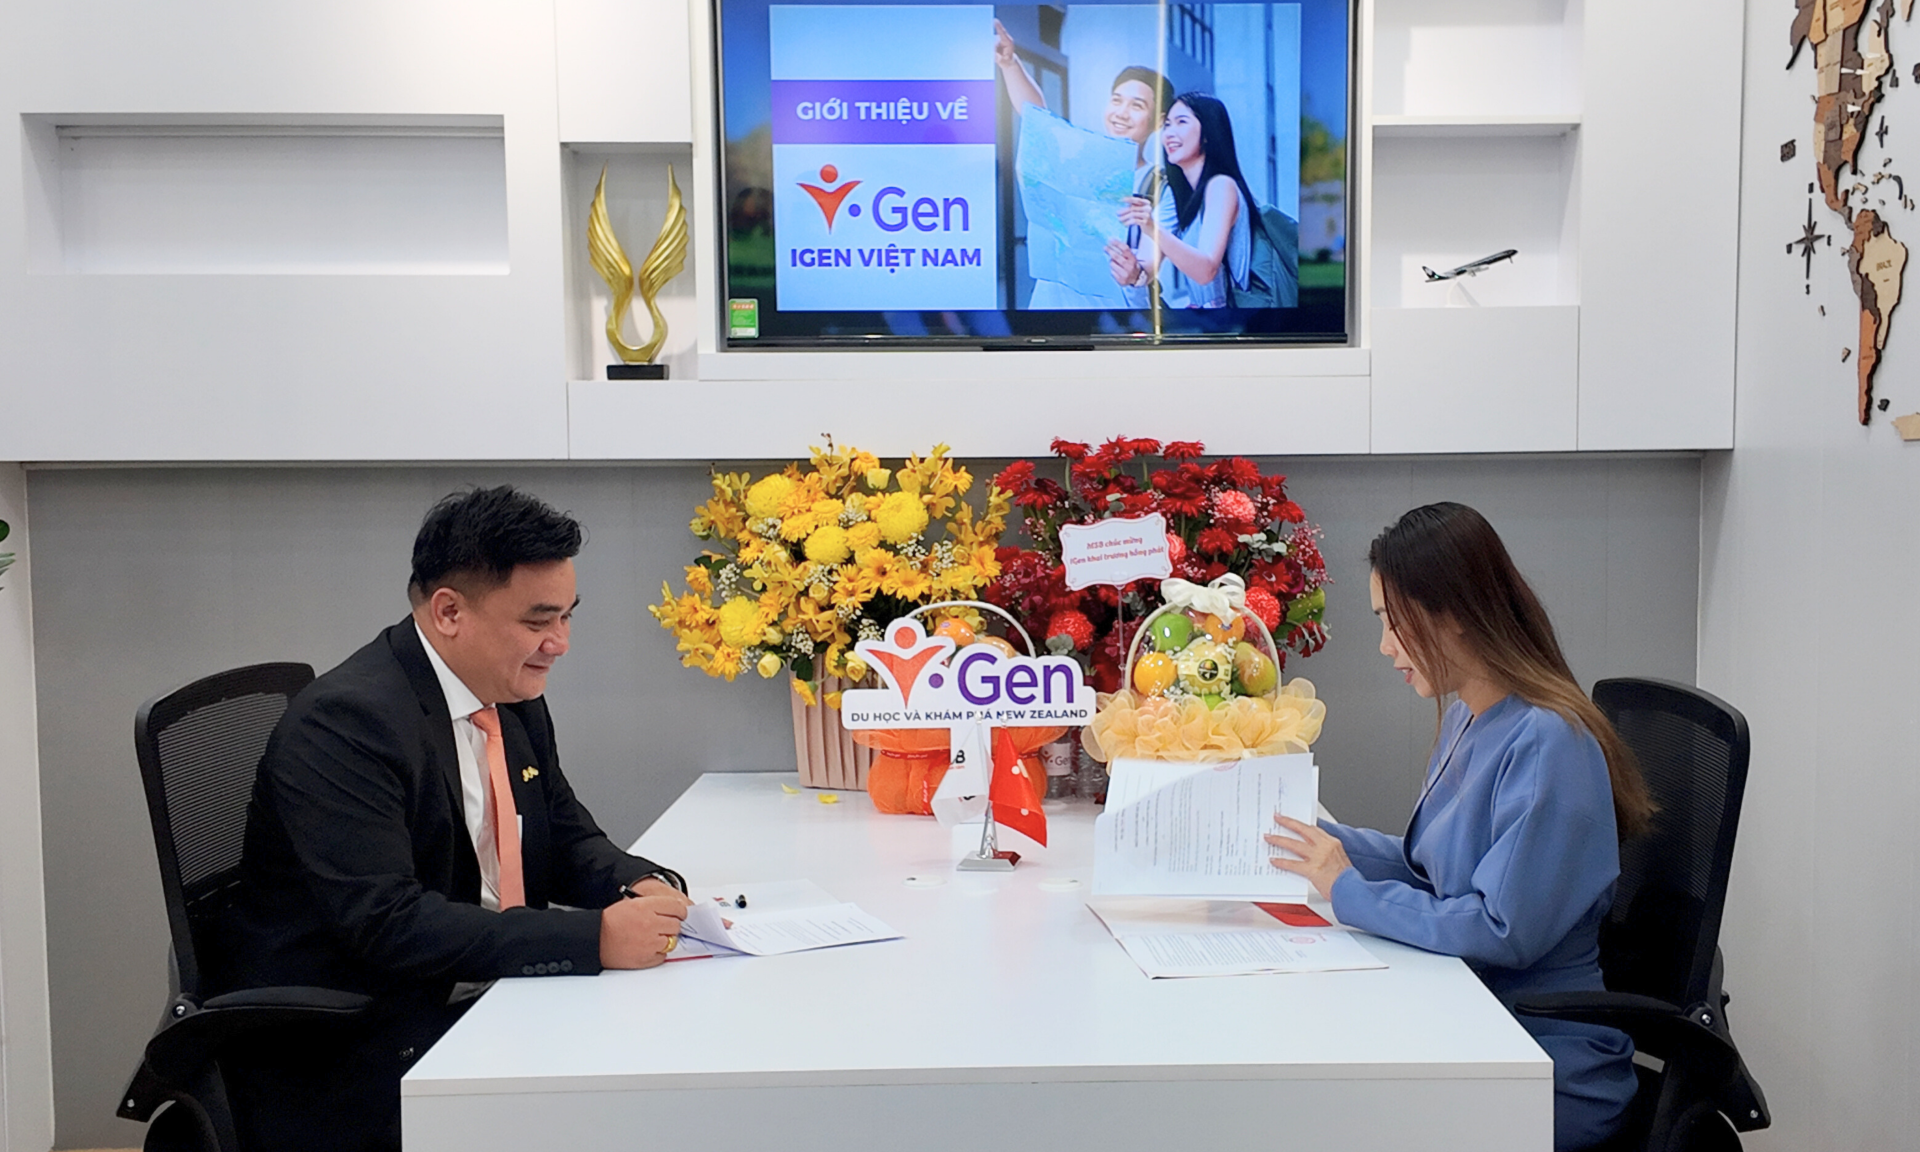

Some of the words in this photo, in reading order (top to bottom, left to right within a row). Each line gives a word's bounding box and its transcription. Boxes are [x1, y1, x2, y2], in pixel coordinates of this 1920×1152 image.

[796, 97, 849, 121] GIỚI
[855, 97, 929, 125] THIỆU
[935, 95, 969, 121] VỀ
[872, 186, 969, 233] Gen
[791, 248, 851, 268] IGEN
[857, 243, 916, 274] VIỆT
[922, 248, 982, 267] NAM
[957, 652, 1074, 706] Gen
[851, 712, 869, 722] DU
[873, 711, 901, 724] HỌC
[904, 709, 921, 721] VÀ
[925, 708, 963, 720] KHÁM
[1029, 709, 1088, 719] ZEALAND
